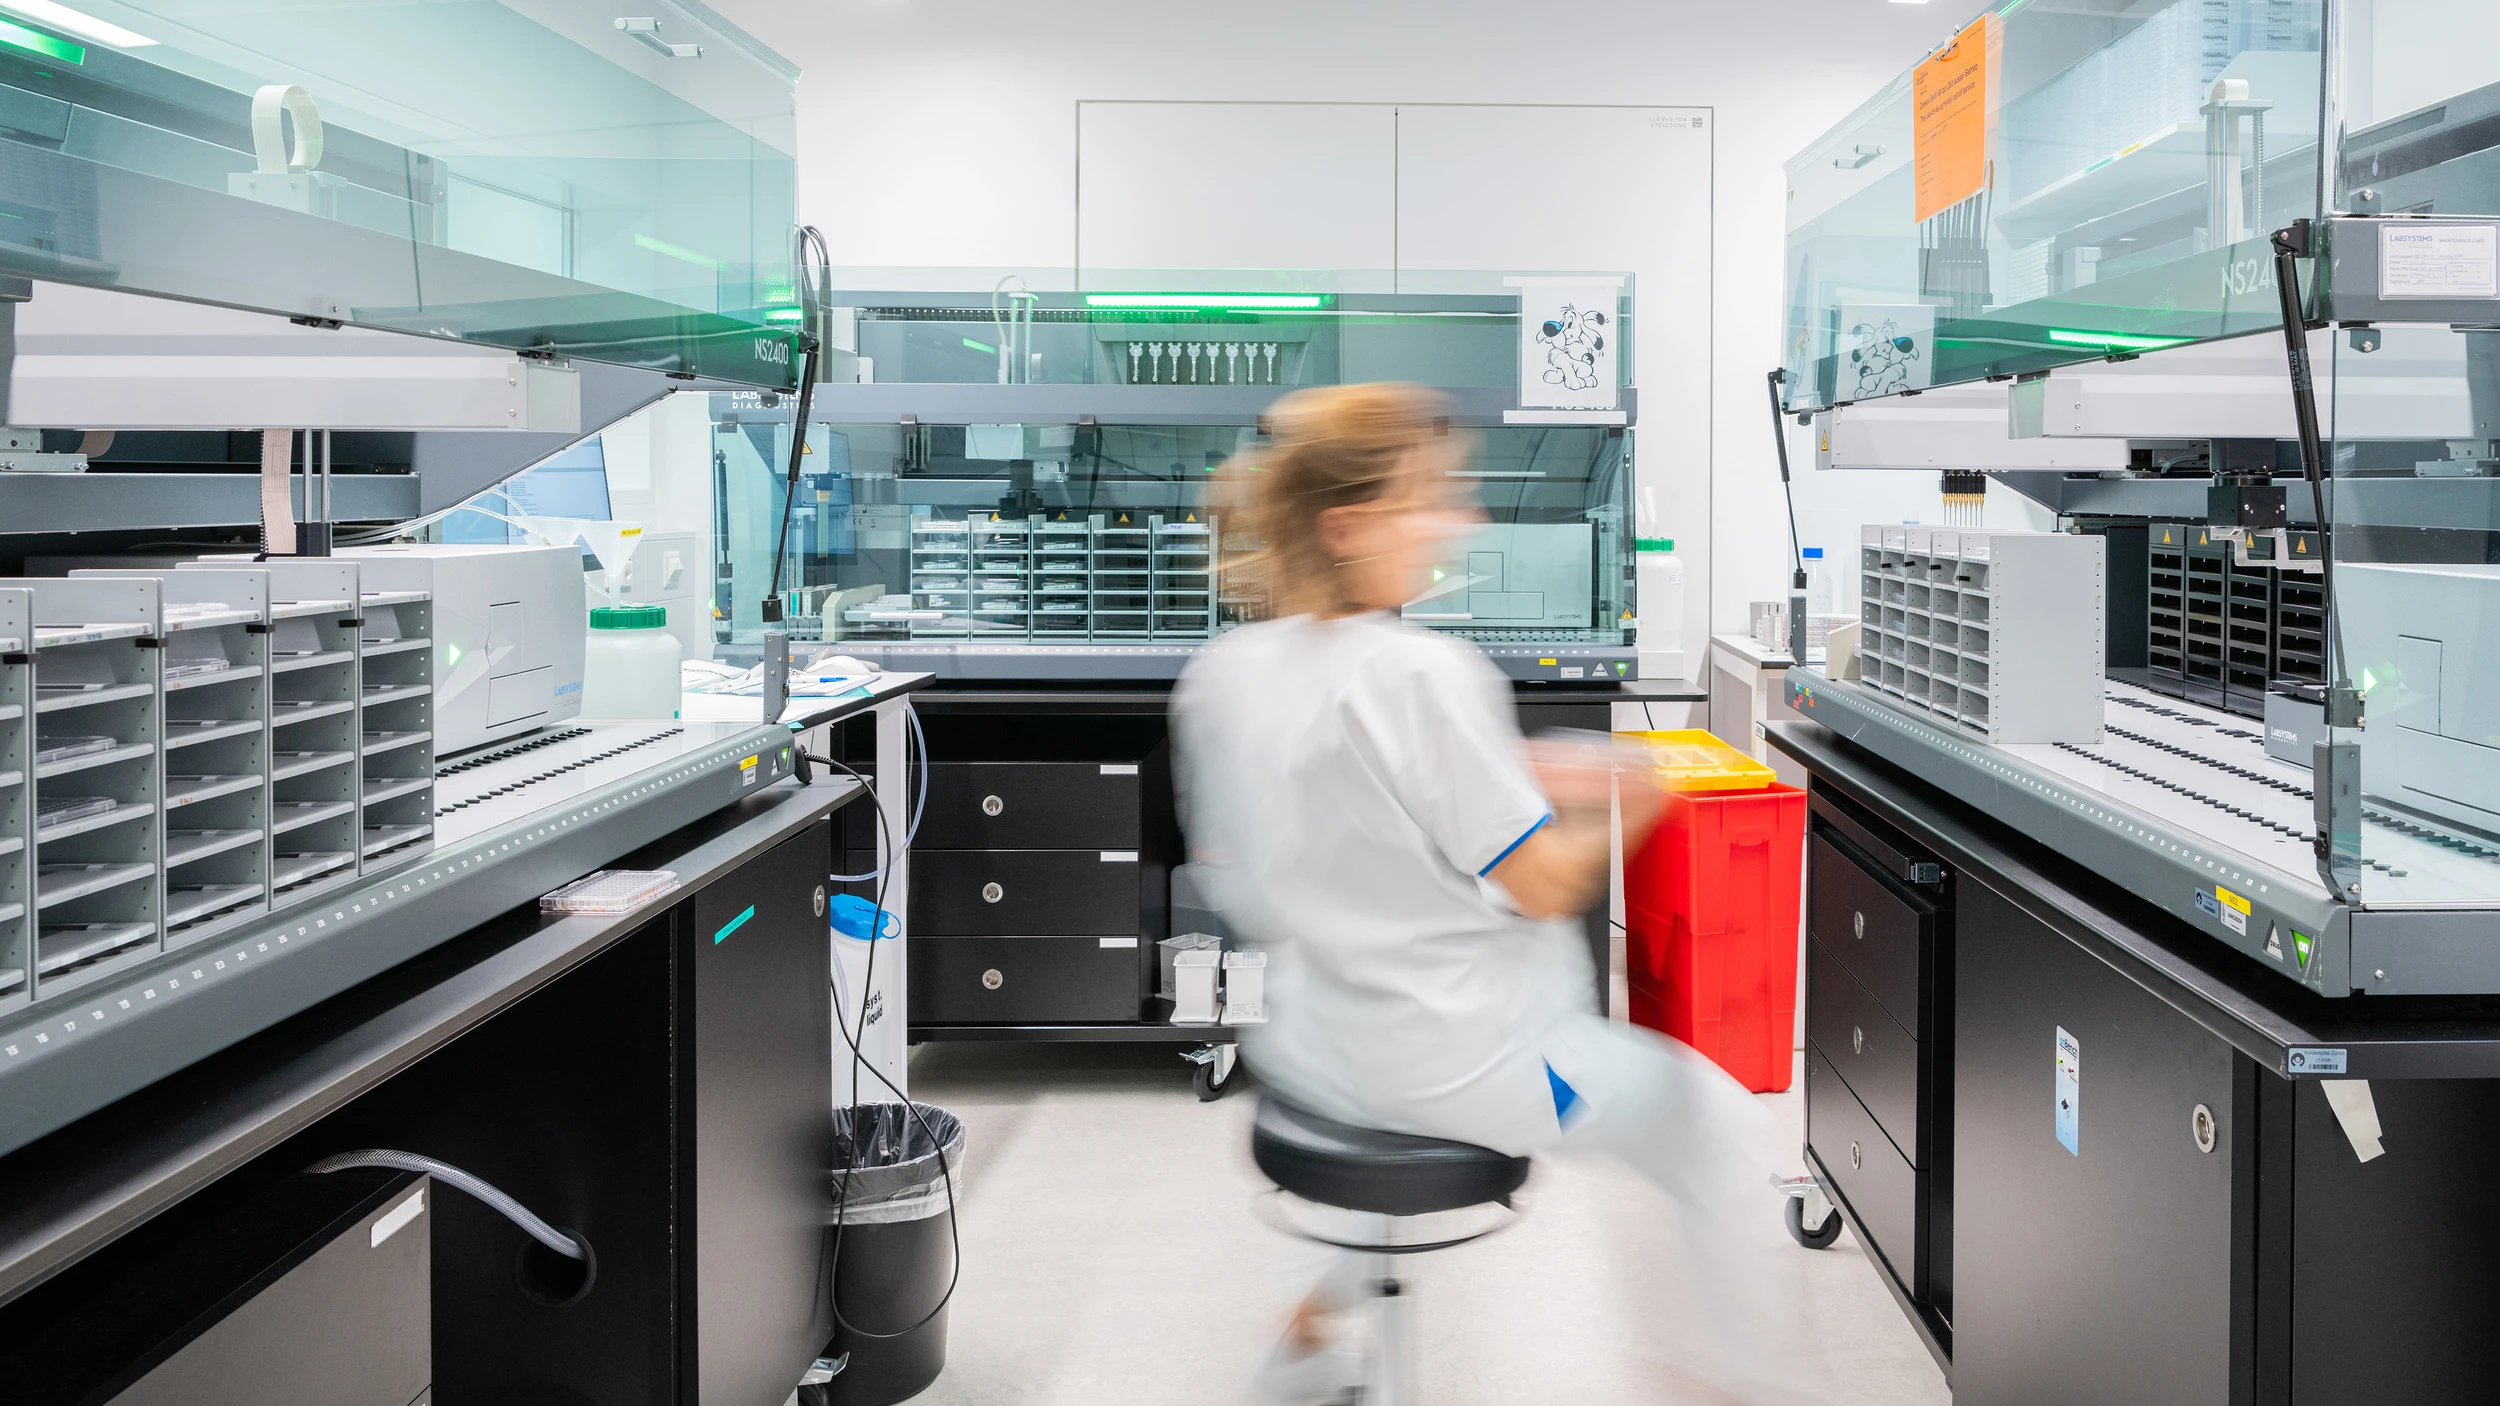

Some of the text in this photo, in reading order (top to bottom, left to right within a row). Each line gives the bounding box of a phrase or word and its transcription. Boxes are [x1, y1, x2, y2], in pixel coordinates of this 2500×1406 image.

[755, 337, 788, 365] NS2400
[554, 681, 582, 697] LABSYSTEMS
[2182, 849, 2190, 858] 63
[2206, 860, 2214, 869] 65
[2245, 878, 2254, 887] 68
[2259, 884, 2268, 893] 69
[4, 1044, 19, 1057] 15
[35, 1032, 49, 1044] 16
[64, 1021, 76, 1032] 17
[91, 1009, 105, 1021] 18
[118, 999, 131, 1010] 19
[143, 988, 157, 1000] 20
[168, 978, 180, 990] 21
[191, 969, 204, 980] 22
[214, 960, 226, 971] 23
[236, 951, 248, 961] 24
[257, 942, 268, 953] 25
[277, 934, 288, 944] 26
[297, 926, 307, 936] 27
[316, 918, 326, 928] 28
[334, 911, 345, 921] 29
[351, 904, 362, 913] 30
[369, 897, 378, 906] 31
[385, 890, 395, 899] 32
[401, 884, 411, 893] 33
[417, 877, 426, 886] 34
[432, 871, 441, 880] 35
[446, 865, 456, 874] 36
[460, 859, 469, 868] 37
[474, 854, 483, 863] 38
[866, 990, 883, 1010] syst.
[866, 1004, 883, 1027] liquid
